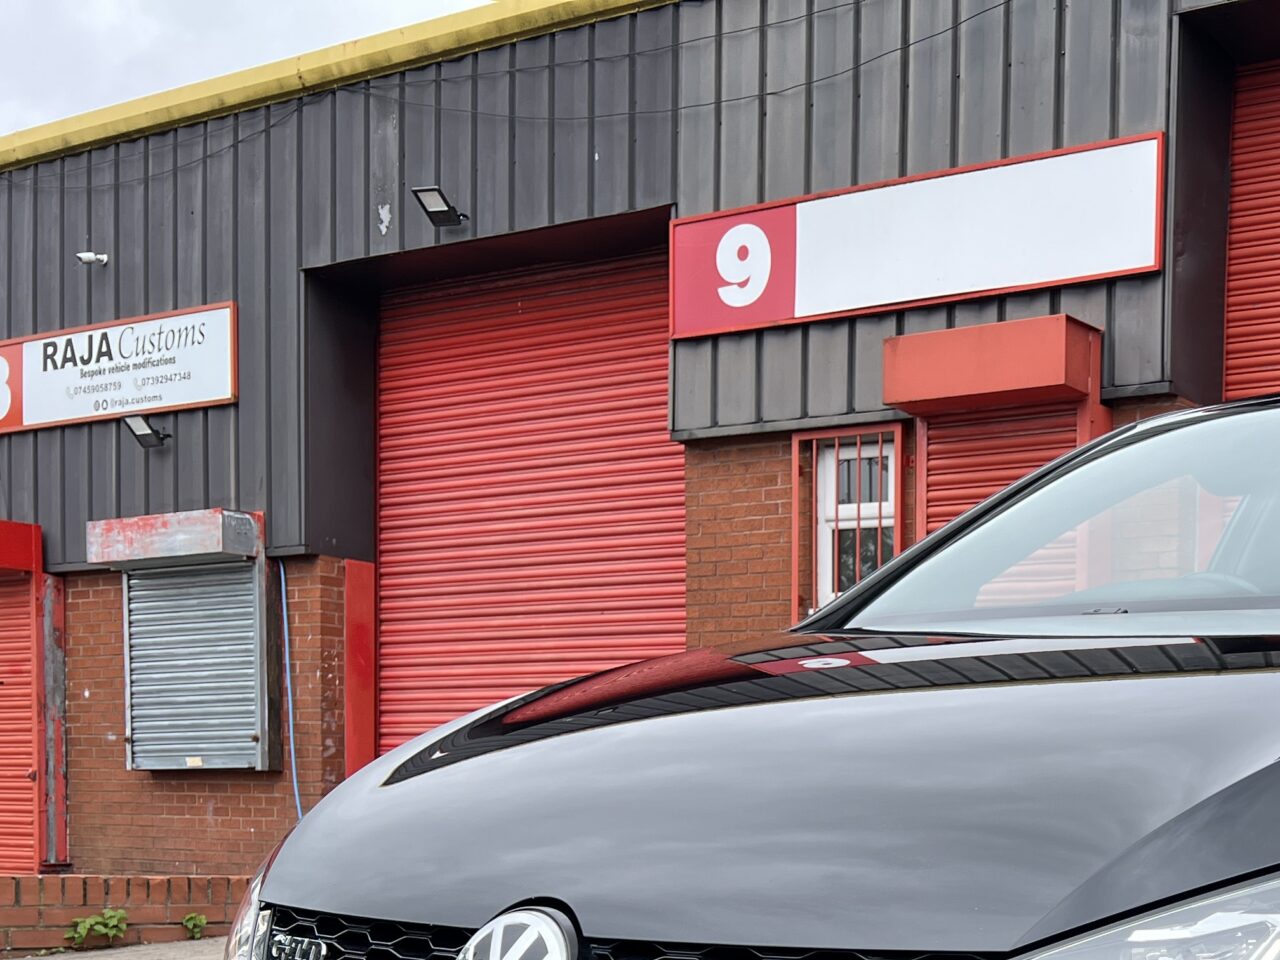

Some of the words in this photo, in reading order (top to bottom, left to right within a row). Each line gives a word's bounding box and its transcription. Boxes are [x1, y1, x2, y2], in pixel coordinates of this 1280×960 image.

[715, 223, 772, 308] 9
[42, 330, 114, 372] RAJA
[118, 321, 206, 360] Customs
[80, 367, 106, 381] Bespoke
[108, 362, 131, 374] vehicle
[132, 355, 177, 371] modifications
